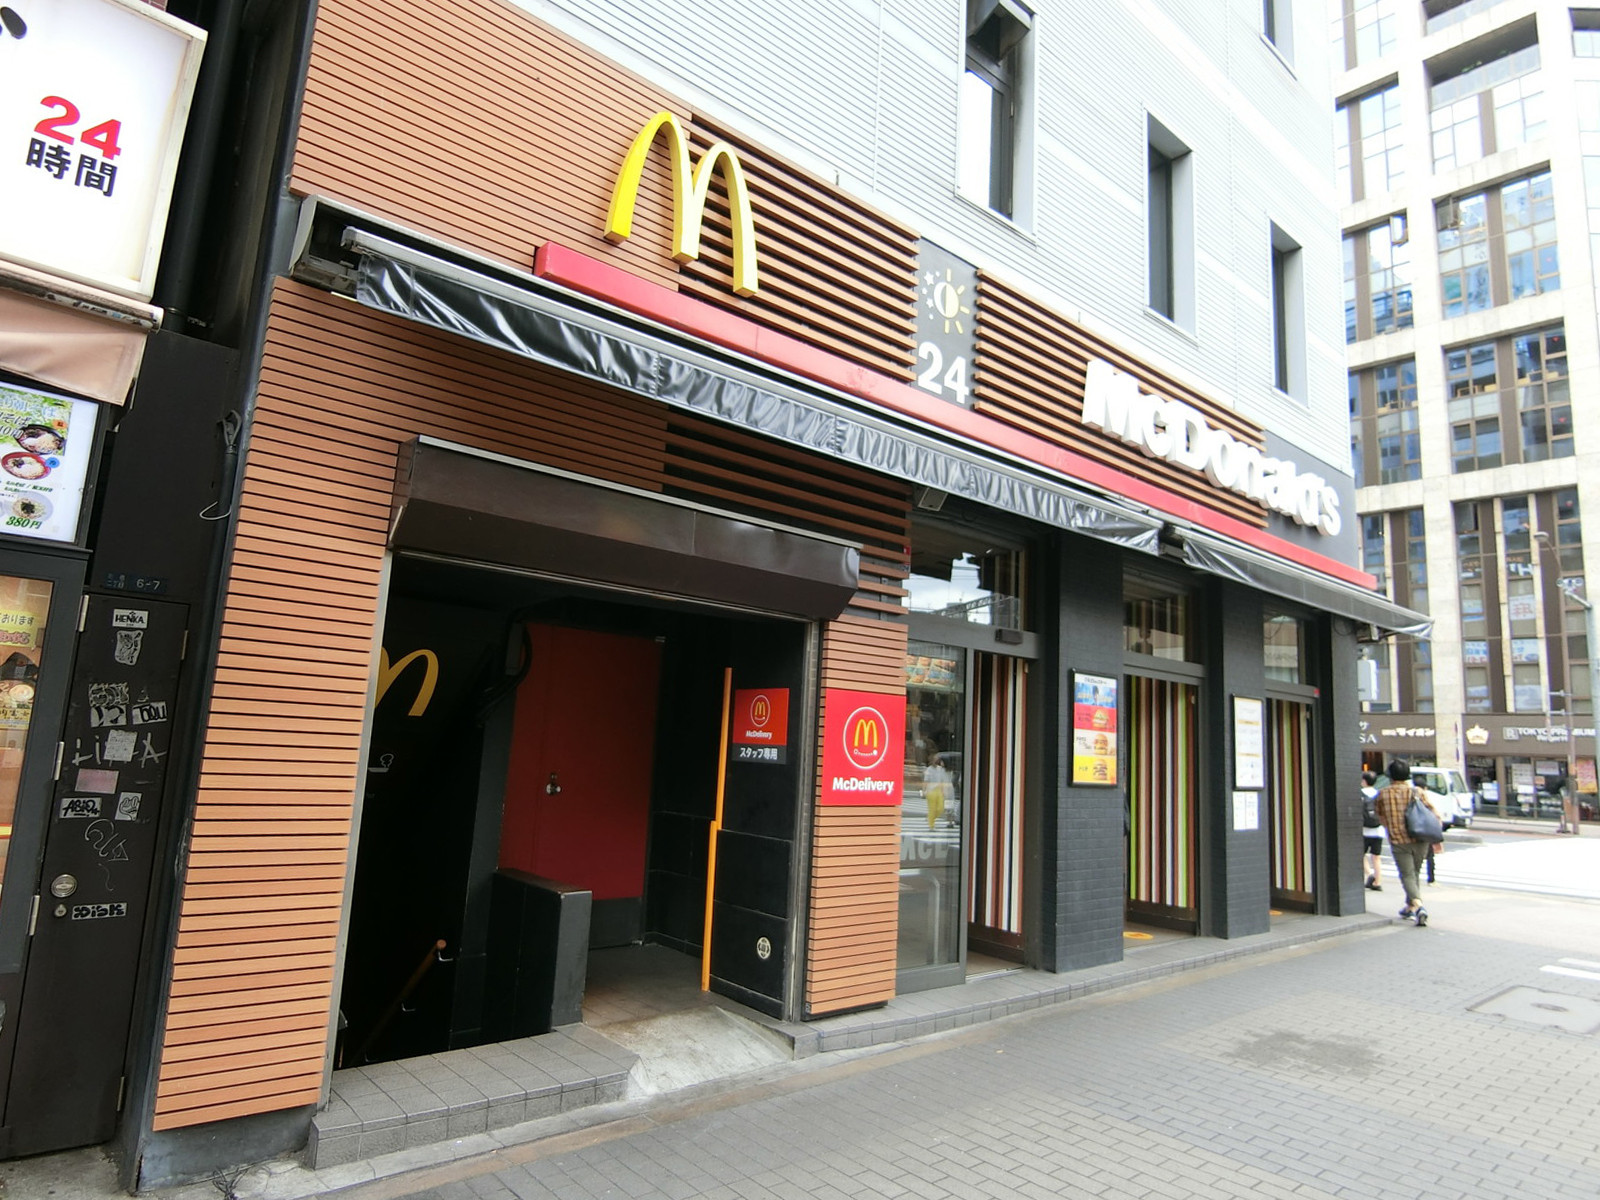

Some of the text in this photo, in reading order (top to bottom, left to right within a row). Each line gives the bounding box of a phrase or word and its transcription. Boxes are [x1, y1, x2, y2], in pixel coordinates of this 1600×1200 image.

[34, 95, 121, 160] 24
[26, 137, 118, 197] 時間
[917, 341, 969, 404] 24
[5, 515, 43, 530] 380円
[136, 578, 160, 590] 6-7
[740, 746, 778, 760] スタッフ専用
[832, 776, 894, 795] McDelivery
